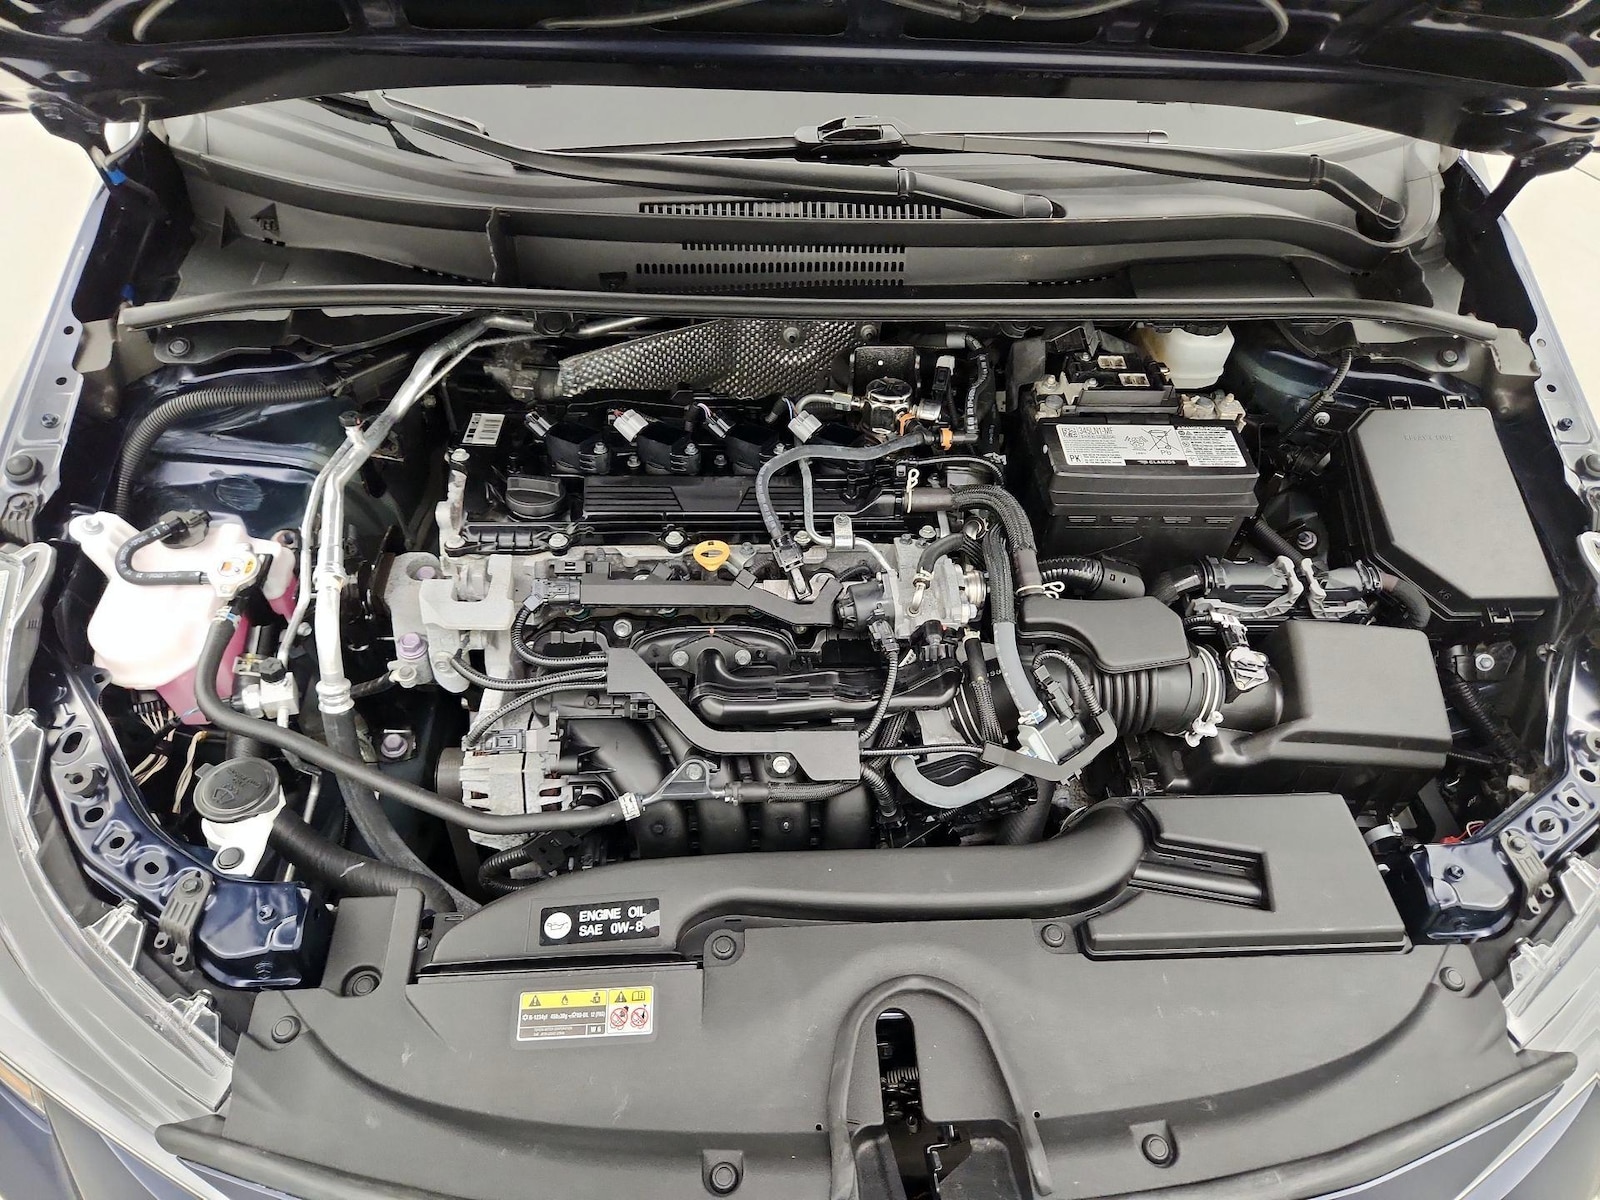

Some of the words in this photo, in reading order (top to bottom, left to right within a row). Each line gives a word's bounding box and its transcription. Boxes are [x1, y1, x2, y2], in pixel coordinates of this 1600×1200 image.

[1069, 454, 1082, 463] PK
[578, 907, 622, 922] ENGINE
[627, 905, 647, 918] OIL
[578, 923, 604, 937] SAE
[610, 920, 644, 935] 0W-8
